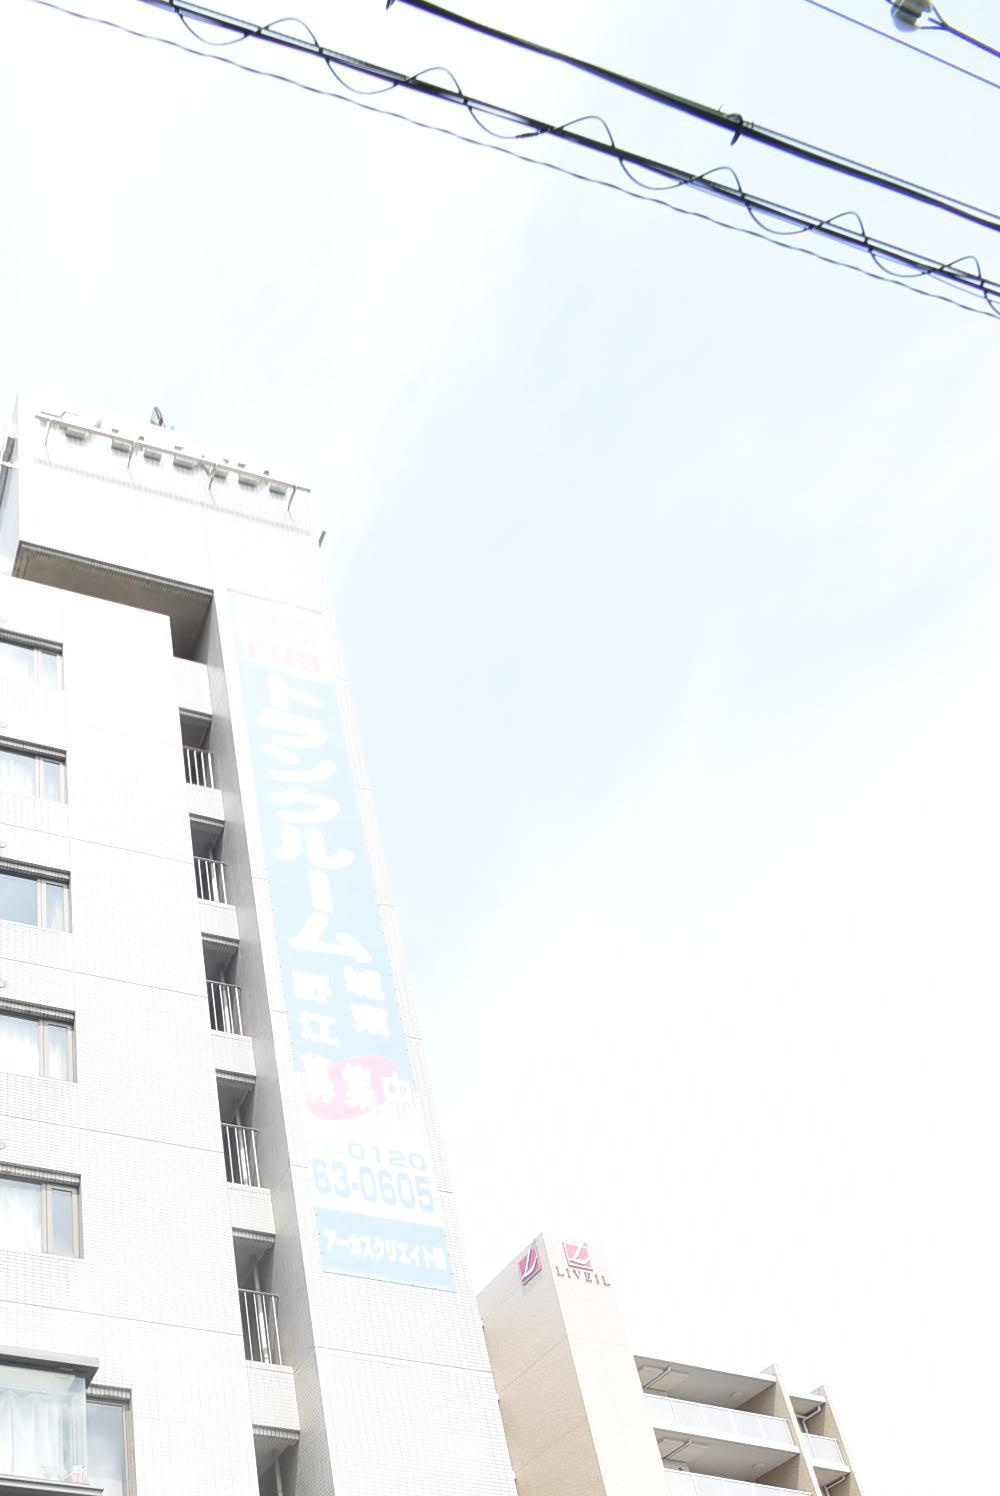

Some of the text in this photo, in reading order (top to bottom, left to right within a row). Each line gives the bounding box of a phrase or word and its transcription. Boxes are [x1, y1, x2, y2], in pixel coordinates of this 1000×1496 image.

[256, 674, 372, 963] トランクルーム
[348, 1143, 426, 1172] 0120
